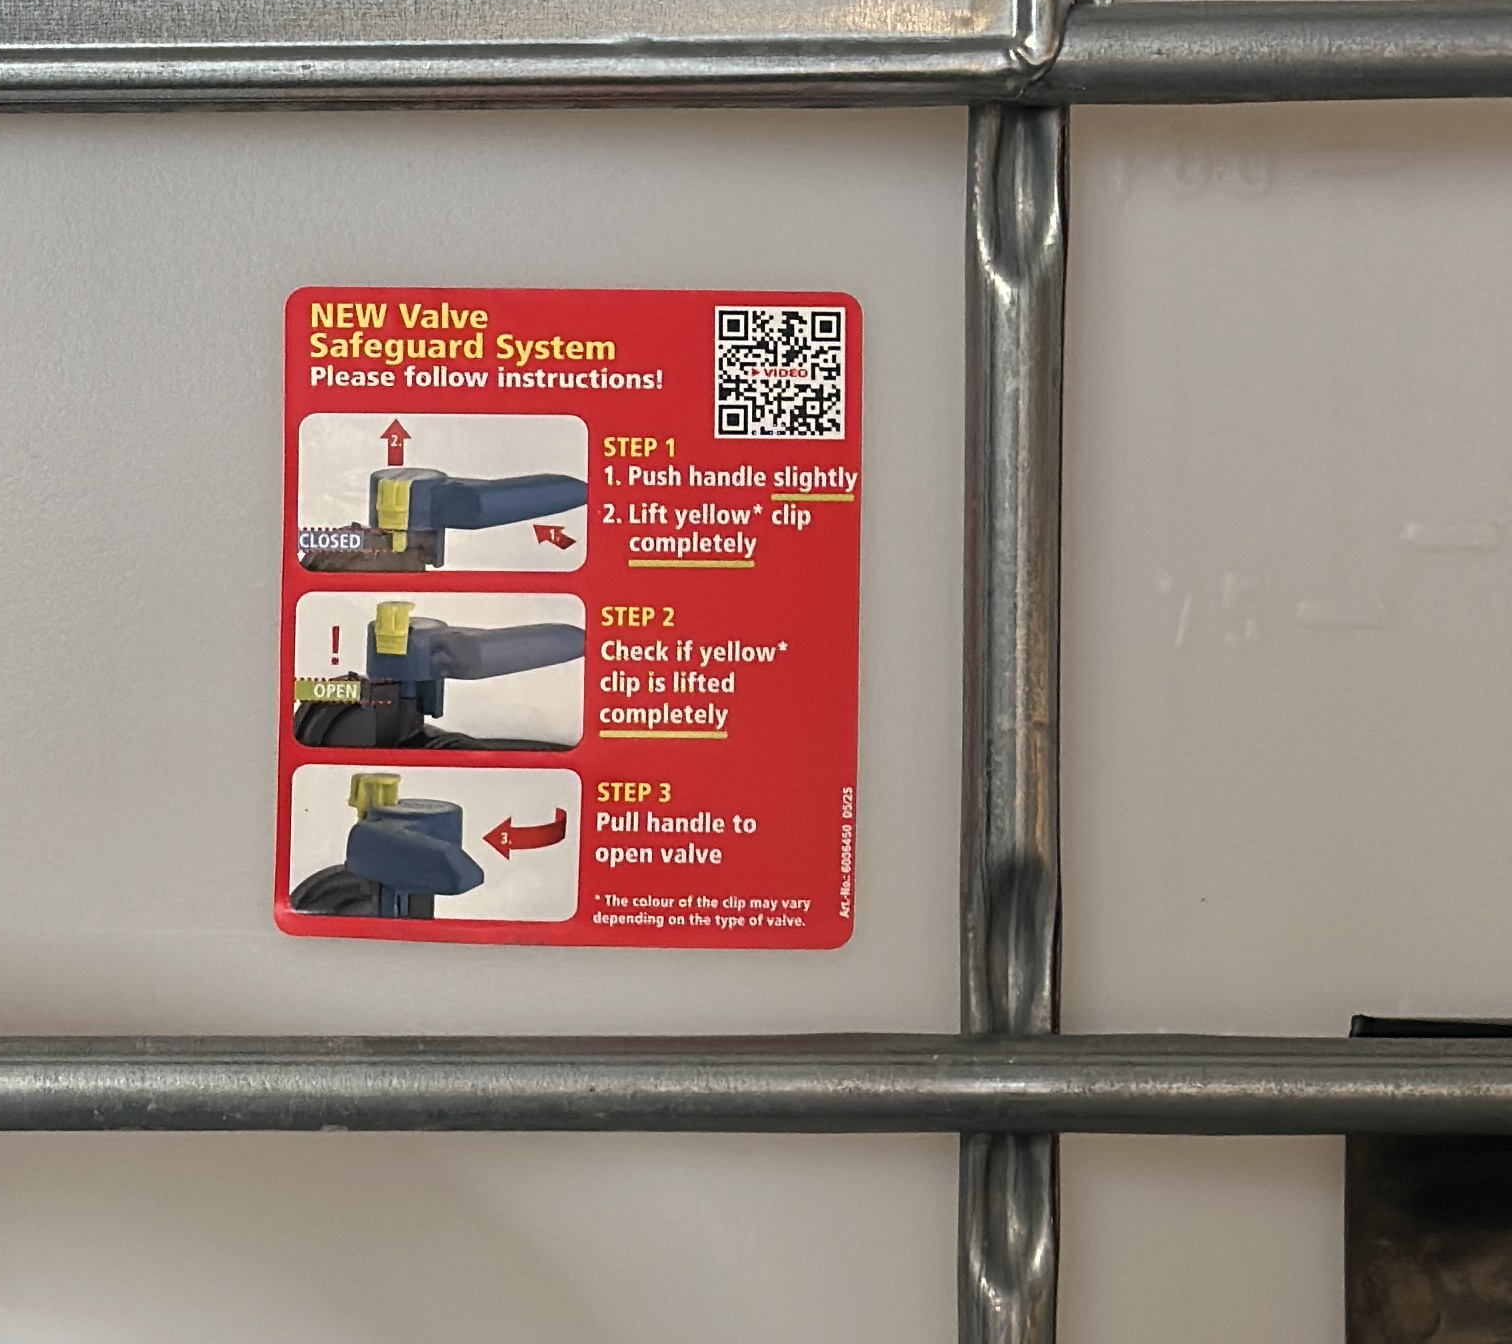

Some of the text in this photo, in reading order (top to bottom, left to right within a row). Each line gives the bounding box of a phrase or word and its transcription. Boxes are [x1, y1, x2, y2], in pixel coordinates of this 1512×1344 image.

[310, 302, 488, 329] NEW Valve
[309, 330, 616, 367] Safeguard System
[310, 364, 664, 390] Please follow instructions!
[763, 368, 809, 378] VIDEO
[390, 434, 403, 447] 2.
[602, 436, 676, 457] STEP 1
[604, 464, 858, 493] 1. Push handle slightly
[602, 504, 623, 524] 2.
[629, 502, 668, 525] Lift
[770, 503, 812, 531] clip
[299, 532, 361, 548] CLOSED
[628, 531, 758, 559] completely
[600, 605, 676, 628] STEP 2
[600, 638, 670, 662] Check
[676, 639, 694, 663] if
[313, 683, 358, 699] OPEN
[599, 669, 736, 698] clip is lifted
[598, 702, 729, 730] completely
[596, 781, 673, 803] STEP 3
[595, 811, 758, 834] Pull handle to
[594, 842, 723, 869] open valve
[605, 894, 629, 908] The
[632, 894, 675, 908] colour
[678, 895, 694, 908] of
[696, 895, 719, 908] the
[722, 896, 747, 912] clip
[749, 898, 778, 912] may
[781, 898, 812, 912] vary
[592, 911, 665, 928] depending
[668, 914, 686, 926] on
[689, 913, 712, 926] the
[714, 914, 746, 930] type
[748, 913, 764, 926] of
